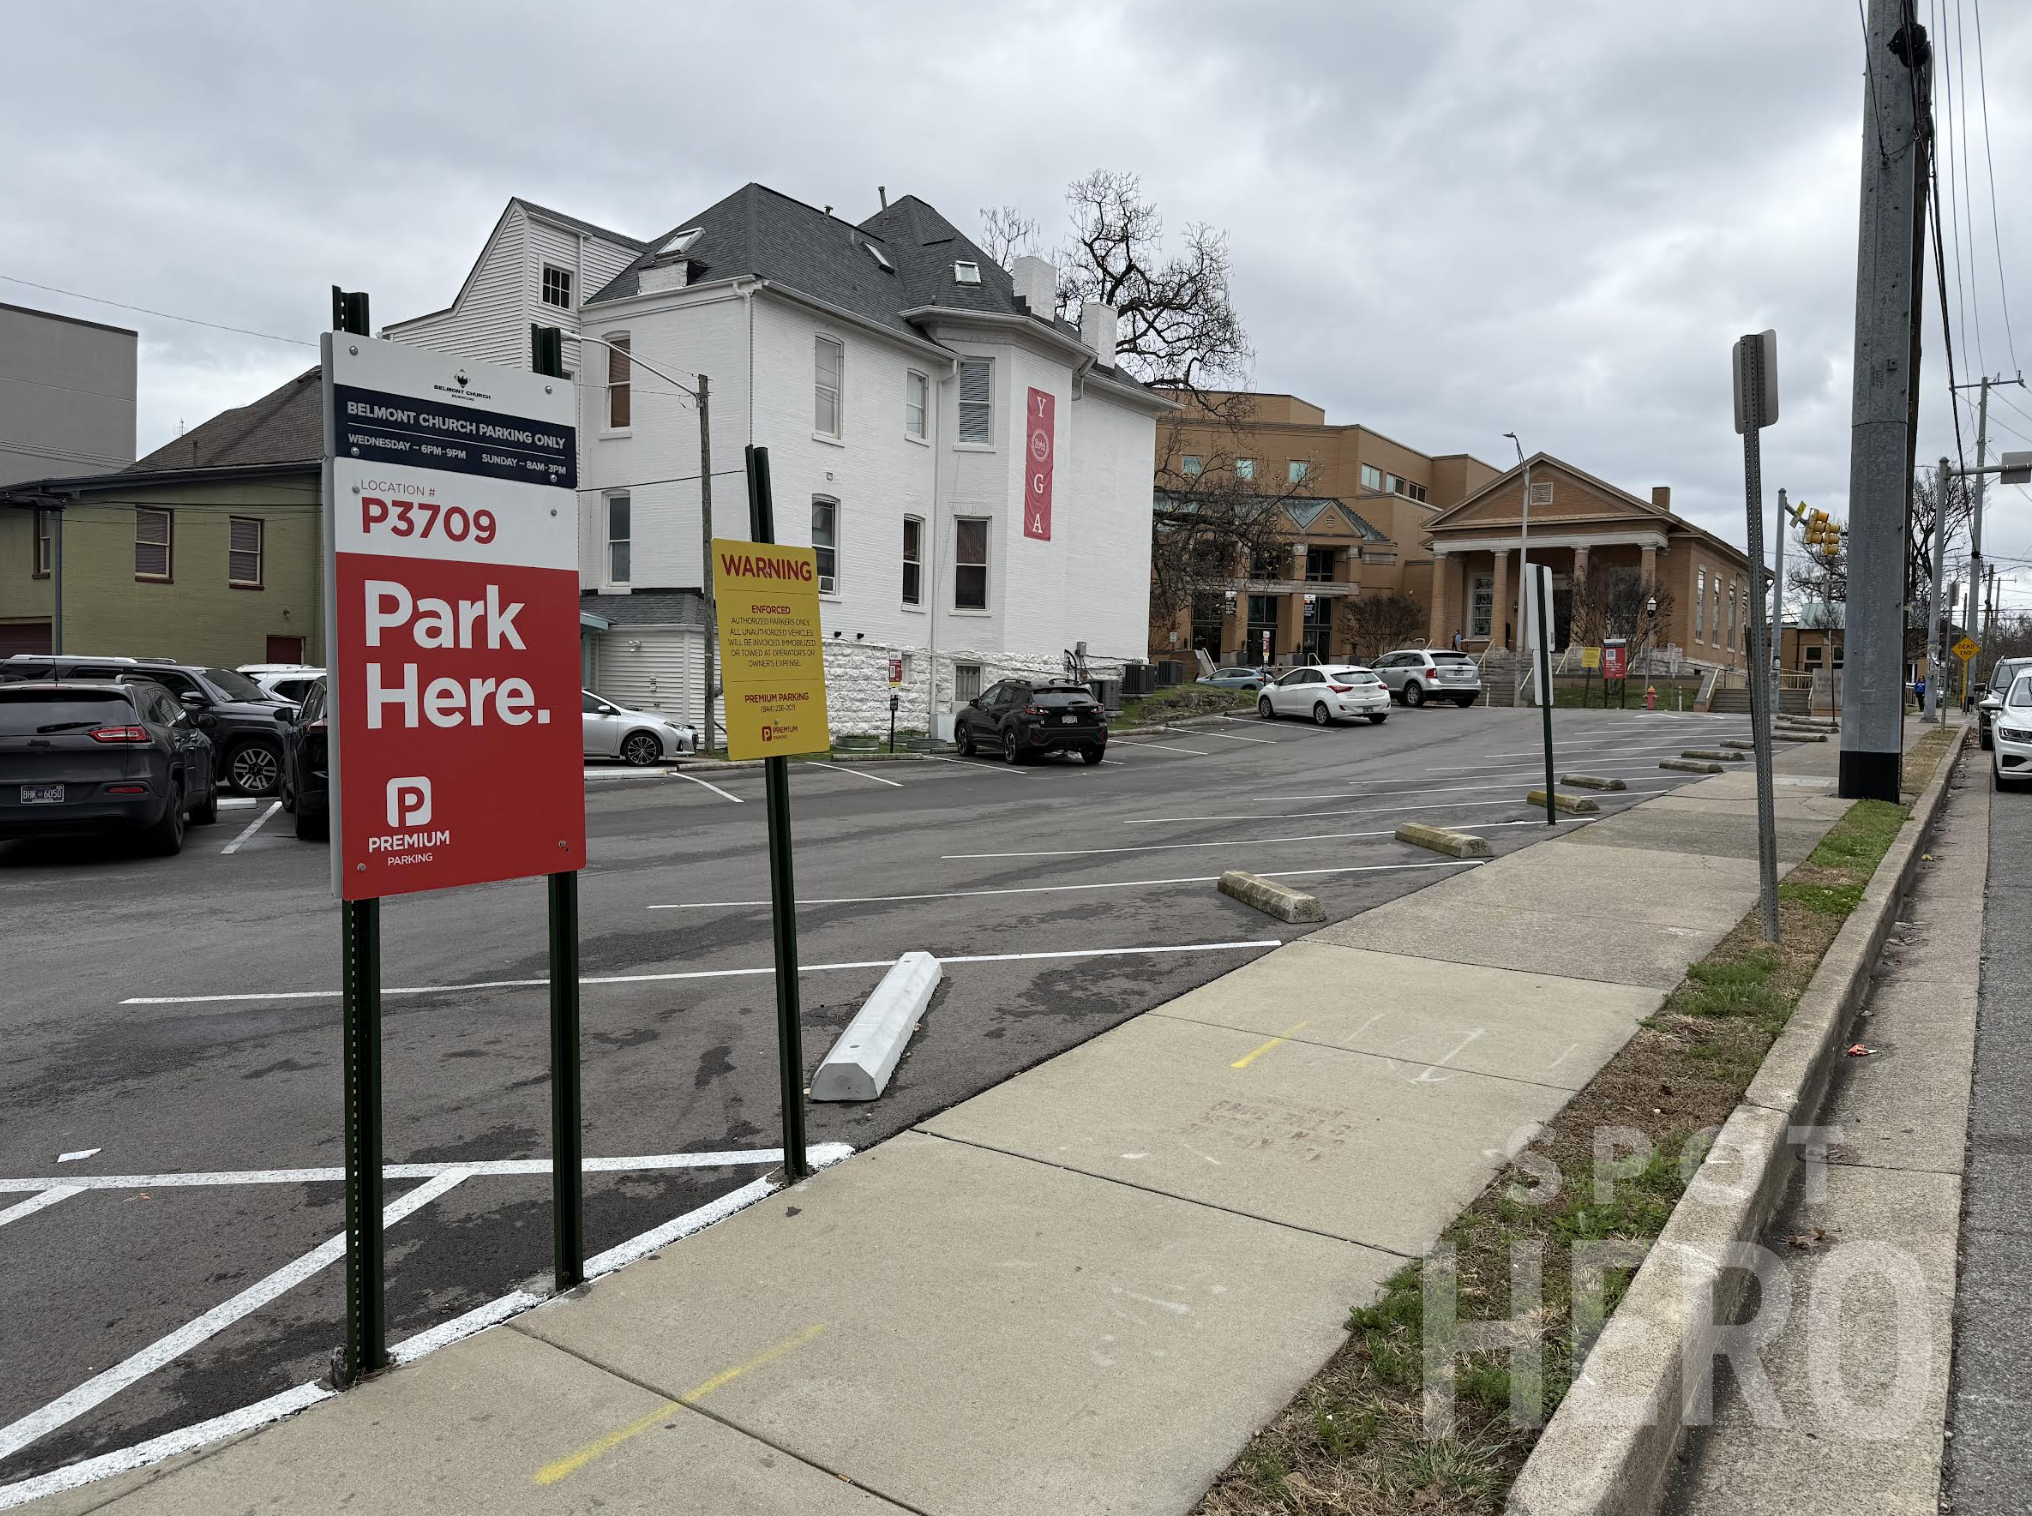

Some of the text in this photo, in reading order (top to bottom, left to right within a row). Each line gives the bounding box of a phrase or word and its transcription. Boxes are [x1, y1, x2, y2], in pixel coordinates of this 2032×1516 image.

[347, 401, 566, 449] BELMONT CHURCH PARKING ONLY
[348, 433, 411, 451] WEDNESDAY
[421, 444, 466, 459] 6PM-9PM
[482, 453, 518, 467] SUNDAY
[526, 460, 567, 475] 8AM-3PM
[360, 479, 436, 497] LOCATION #
[361, 496, 497, 545] P3709
[721, 553, 812, 582] WARNING
[364, 579, 527, 650] Park
[751, 605, 791, 614] ENFORCED
[731, 617, 811, 626] AUTHORIZED PARKERS ONLY
[742, 628, 787, 636] UNAUTHORIZED
[787, 629, 814, 637] VEHICLES
[728, 638, 742, 646] WILL
[744, 638, 752, 646] BE
[782, 639, 816, 647] IMMOBILIZED
[731, 649, 740, 657] OR
[741, 649, 763, 657] TOWED
[764, 649, 771, 657] AT
[366, 662, 551, 729] Here.
[744, 692, 810, 703] PREMIUM PARKING
[773, 726, 799, 734] PREMIUM
[368, 830, 450, 853] PREMIUM
[387, 852, 433, 867] PARKING
